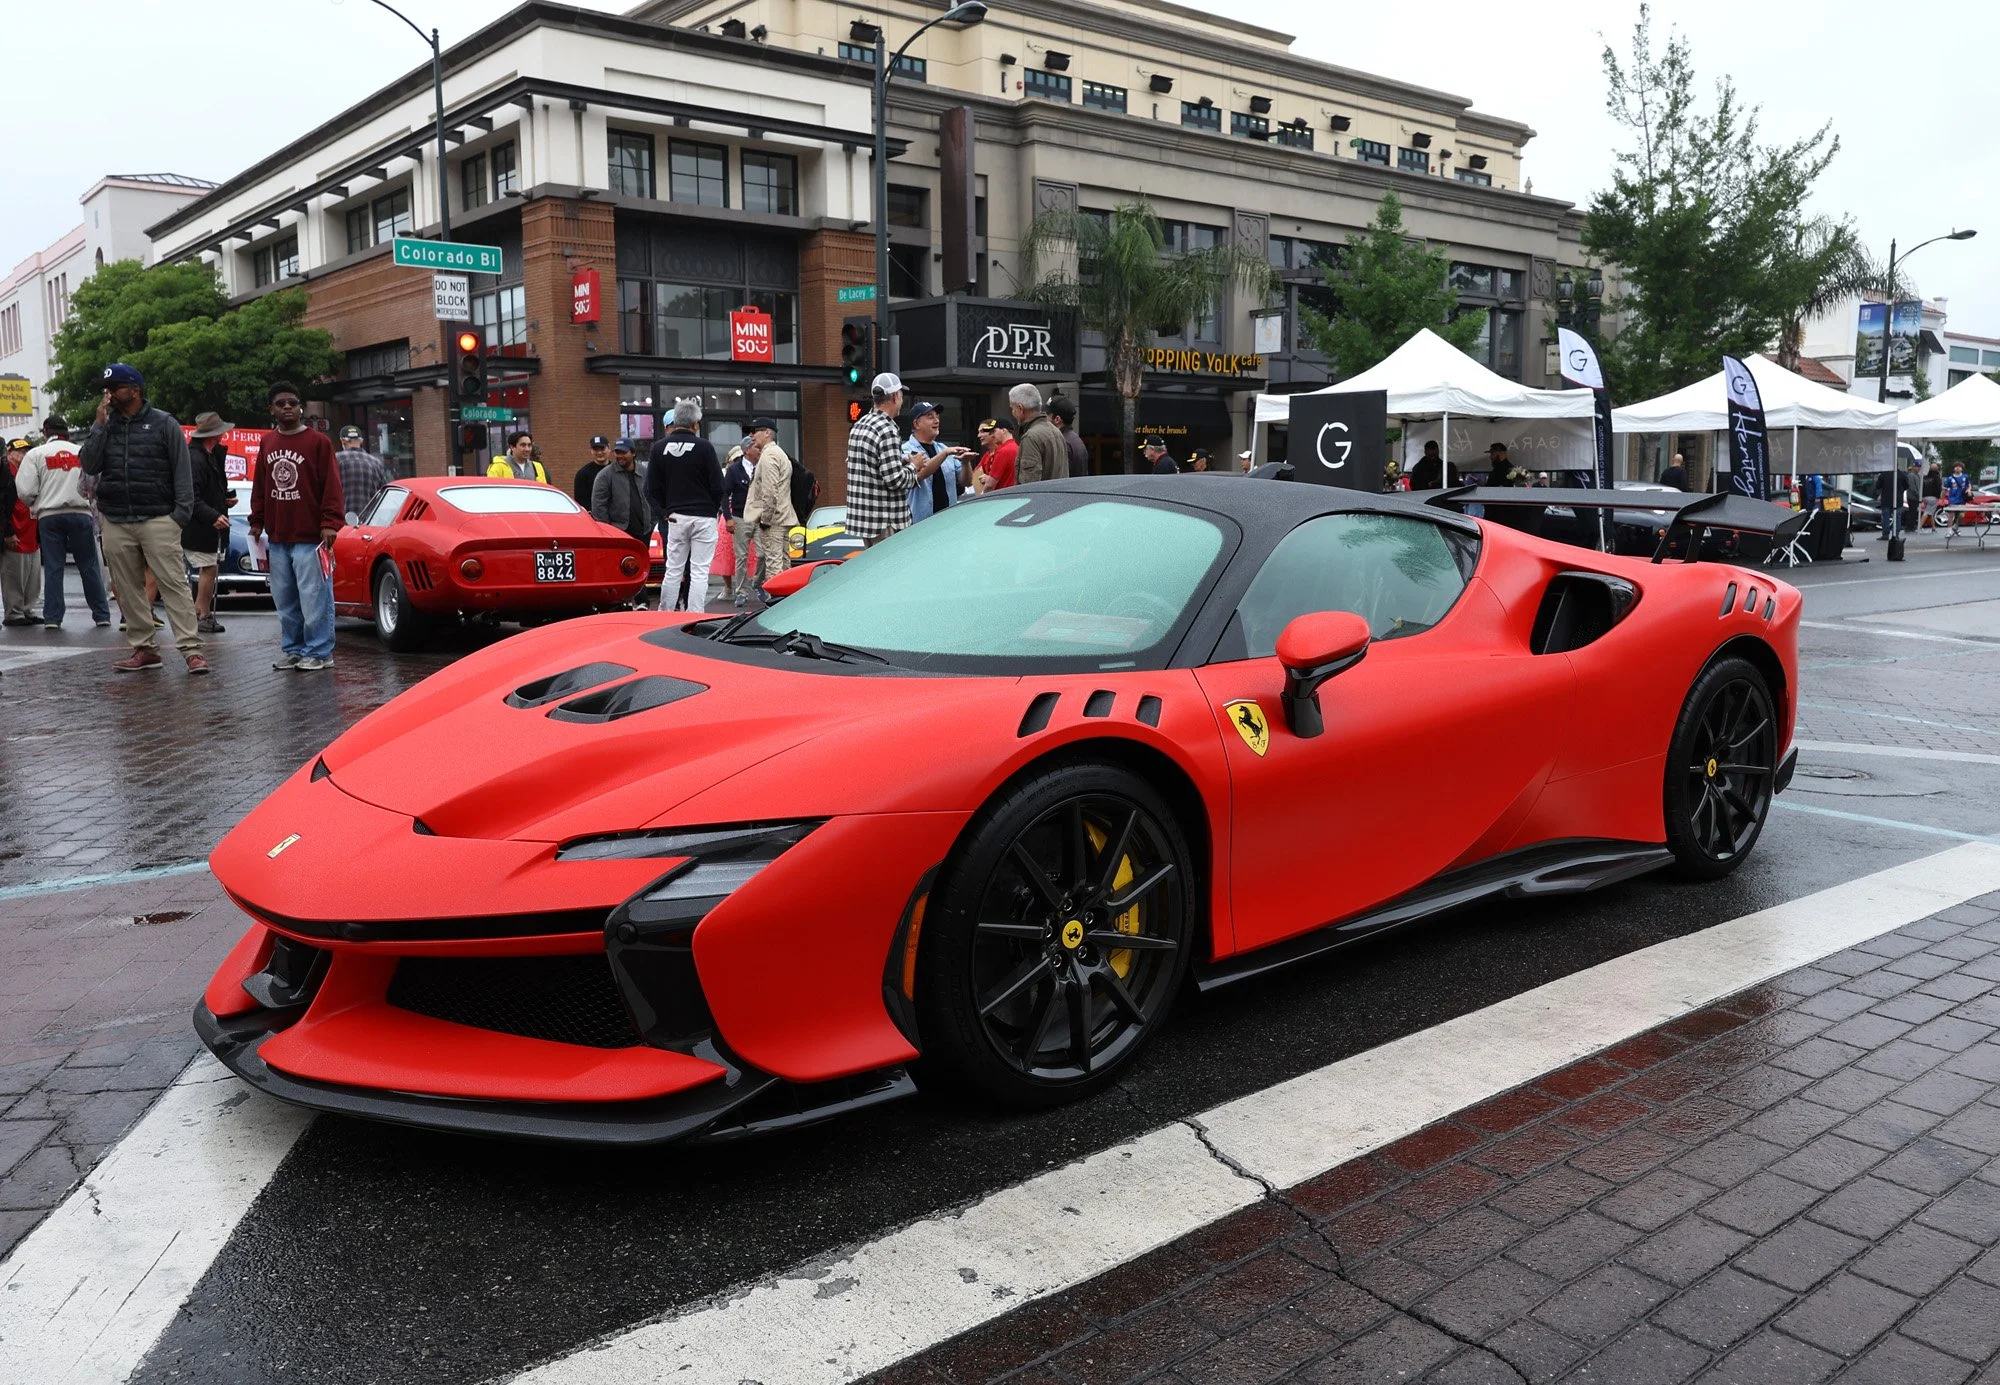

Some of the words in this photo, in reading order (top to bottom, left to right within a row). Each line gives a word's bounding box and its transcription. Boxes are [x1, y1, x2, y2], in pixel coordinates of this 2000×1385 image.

[401, 245, 474, 265] Colorado
[480, 252, 496, 267] Bl
[435, 280, 447, 290] DO
[450, 281, 466, 292] NOT
[574, 282, 590, 298] MINI
[839, 289, 847, 300] De
[849, 288, 866, 300] Lacey
[437, 295, 466, 306] BLOCK
[436, 308, 468, 316] INTERSECTION
[735, 322, 767, 338] MINI
[986, 326, 1055, 358] DPR
[986, 360, 1055, 372] CONSTRUCTION
[1241, 353, 1263, 367] cafe
[1, 383, 24, 392] Public
[462, 407, 497, 419] Colorado
[1142, 425, 1157, 434] there
[1159, 425, 1166, 434] be
[1167, 425, 1188, 434] brunch
[232, 430, 261, 442] FERR
[1316, 421, 1352, 469] G
[266, 449, 305, 465] HILLMAN
[1732, 411, 1762, 499] Heritag
[271, 489, 301, 500] CLEGE
[555, 553, 573, 566] 85
[538, 567, 573, 580] 8844
